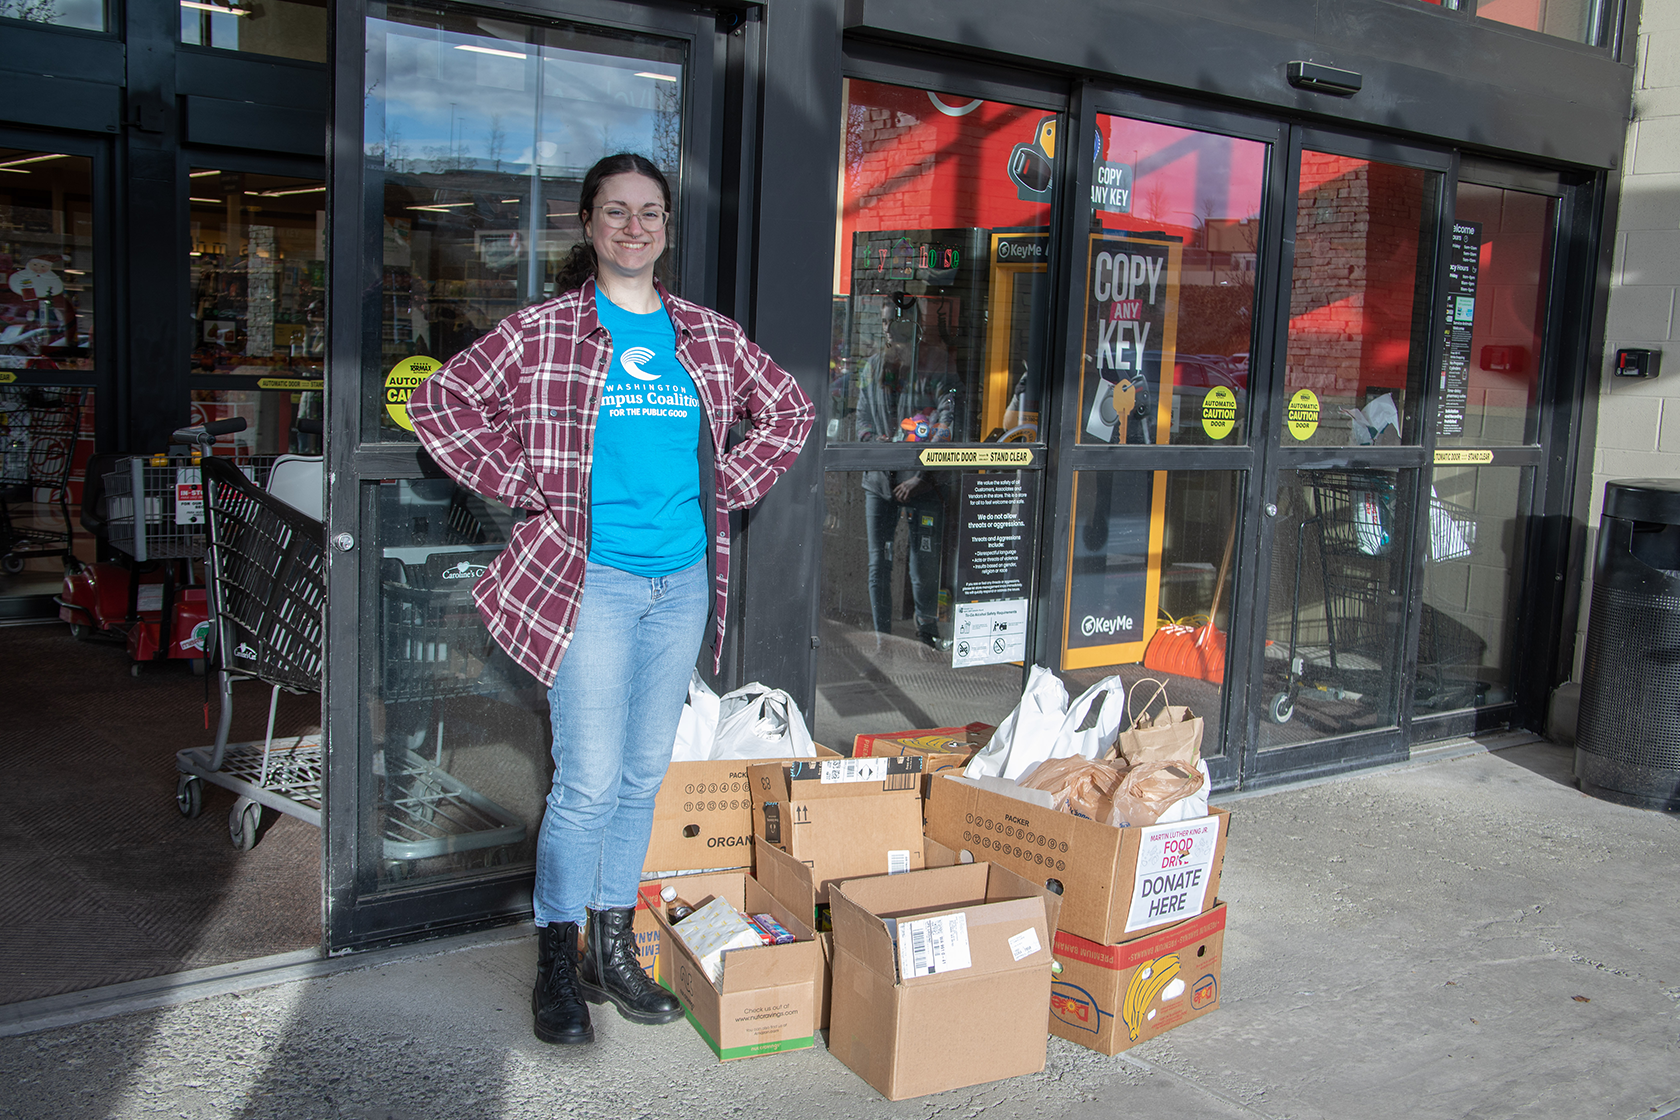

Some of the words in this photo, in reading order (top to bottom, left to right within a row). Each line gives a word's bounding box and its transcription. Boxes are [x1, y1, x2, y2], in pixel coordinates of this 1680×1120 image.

[1098, 166, 1122, 186] COPY
[1110, 188, 1128, 206] KEY
[1010, 244, 1042, 258] KeyMe
[1094, 252, 1163, 304] COPY
[1114, 302, 1139, 319] ANY
[1096, 319, 1150, 370] KEY
[606, 384, 686, 393] WASHINGTON
[601, 394, 643, 407] mpus
[647, 392, 700, 407] Coalitio
[610, 408, 625, 417] FOR
[668, 410, 687, 418] GOOD
[1202, 409, 1235, 419] CAUTION
[1288, 411, 1318, 421] CAUTION
[926, 452, 960, 462] AUTOMATIC
[961, 452, 977, 462] DOOR
[990, 452, 1008, 462] STAND
[1010, 452, 1027, 461] CLEAR
[441, 570, 475, 579] Caroline's
[1095, 615, 1133, 635] KeyMe
[1005, 814, 1030, 827] PACKER
[1150, 832, 1169, 842] MARTIN
[1170, 830, 1189, 839] LUTHER
[1189, 828, 1201, 836] KING
[1164, 838, 1193, 854] FOOD
[1162, 855, 1189, 868] DRI
[1142, 869, 1202, 898] DONATE
[1148, 893, 1187, 918] HERE
[1180, 929, 1198, 944] BANANAS
[1130, 947, 1154, 961] BANANAS
[1155, 940, 1177, 955] PREMIUM
[1080, 948, 1114, 964] PREMIUM
[1194, 985, 1212, 1004] Dole
[735, 1009, 798, 1022] www.nutcravings.com
[1051, 995, 1089, 1022] Dole
